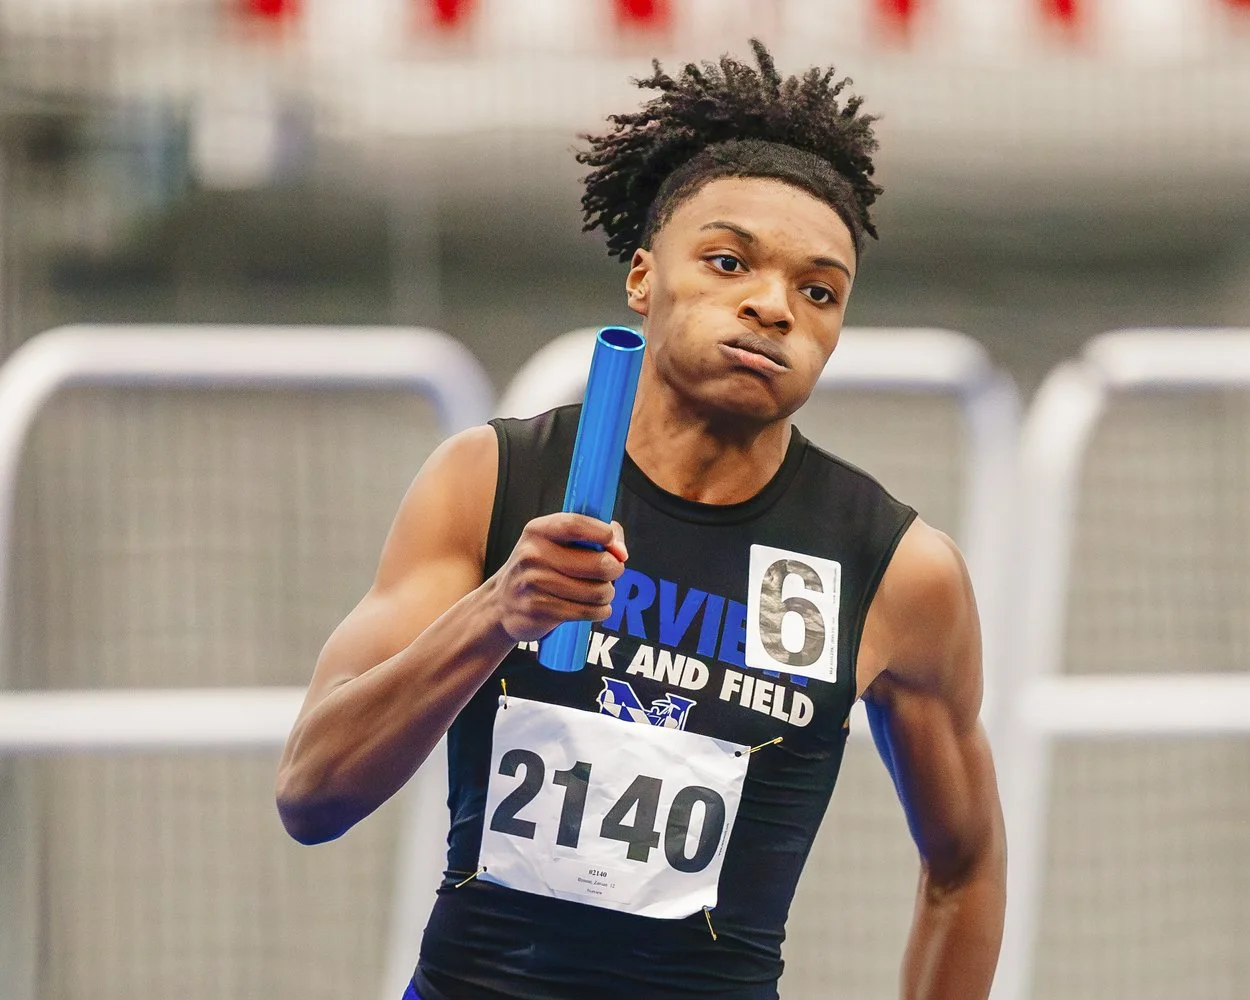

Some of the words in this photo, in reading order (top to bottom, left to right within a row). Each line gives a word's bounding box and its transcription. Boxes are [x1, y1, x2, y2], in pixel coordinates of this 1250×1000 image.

[759, 559, 825, 667] 6
[625, 644, 710, 690] AND
[719, 669, 815, 727] FIELD
[489, 748, 726, 873] 2140
